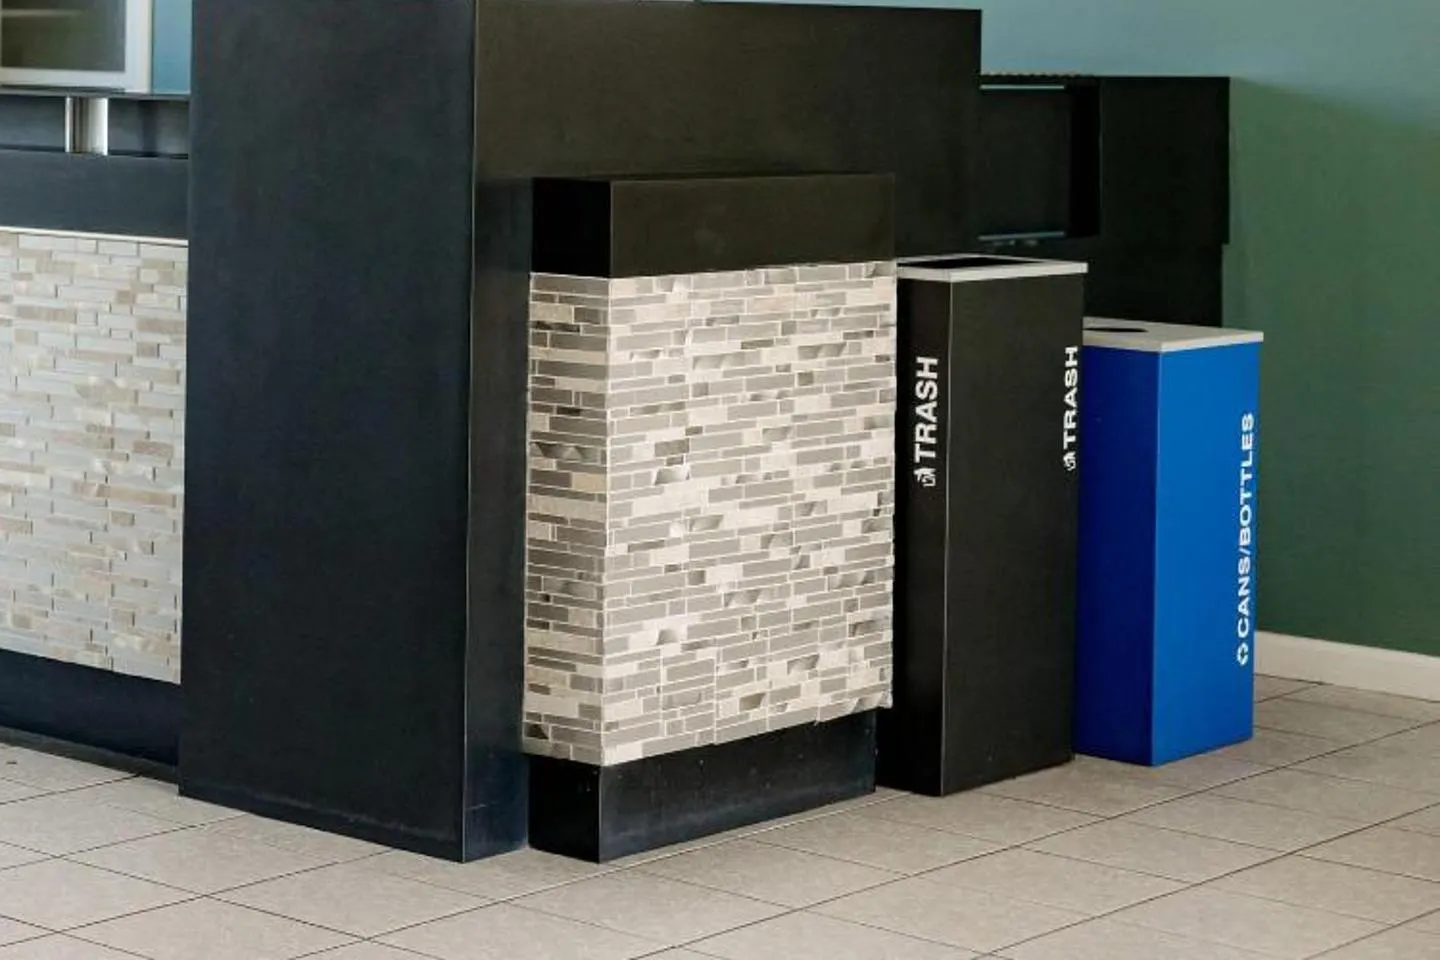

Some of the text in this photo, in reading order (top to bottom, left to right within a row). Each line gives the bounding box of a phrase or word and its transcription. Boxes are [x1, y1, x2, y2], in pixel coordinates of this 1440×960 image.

[914, 356, 939, 463] TRASH
[1063, 345, 1079, 449] TRASH
[1237, 413, 1255, 638] CANS/BOTTLES
